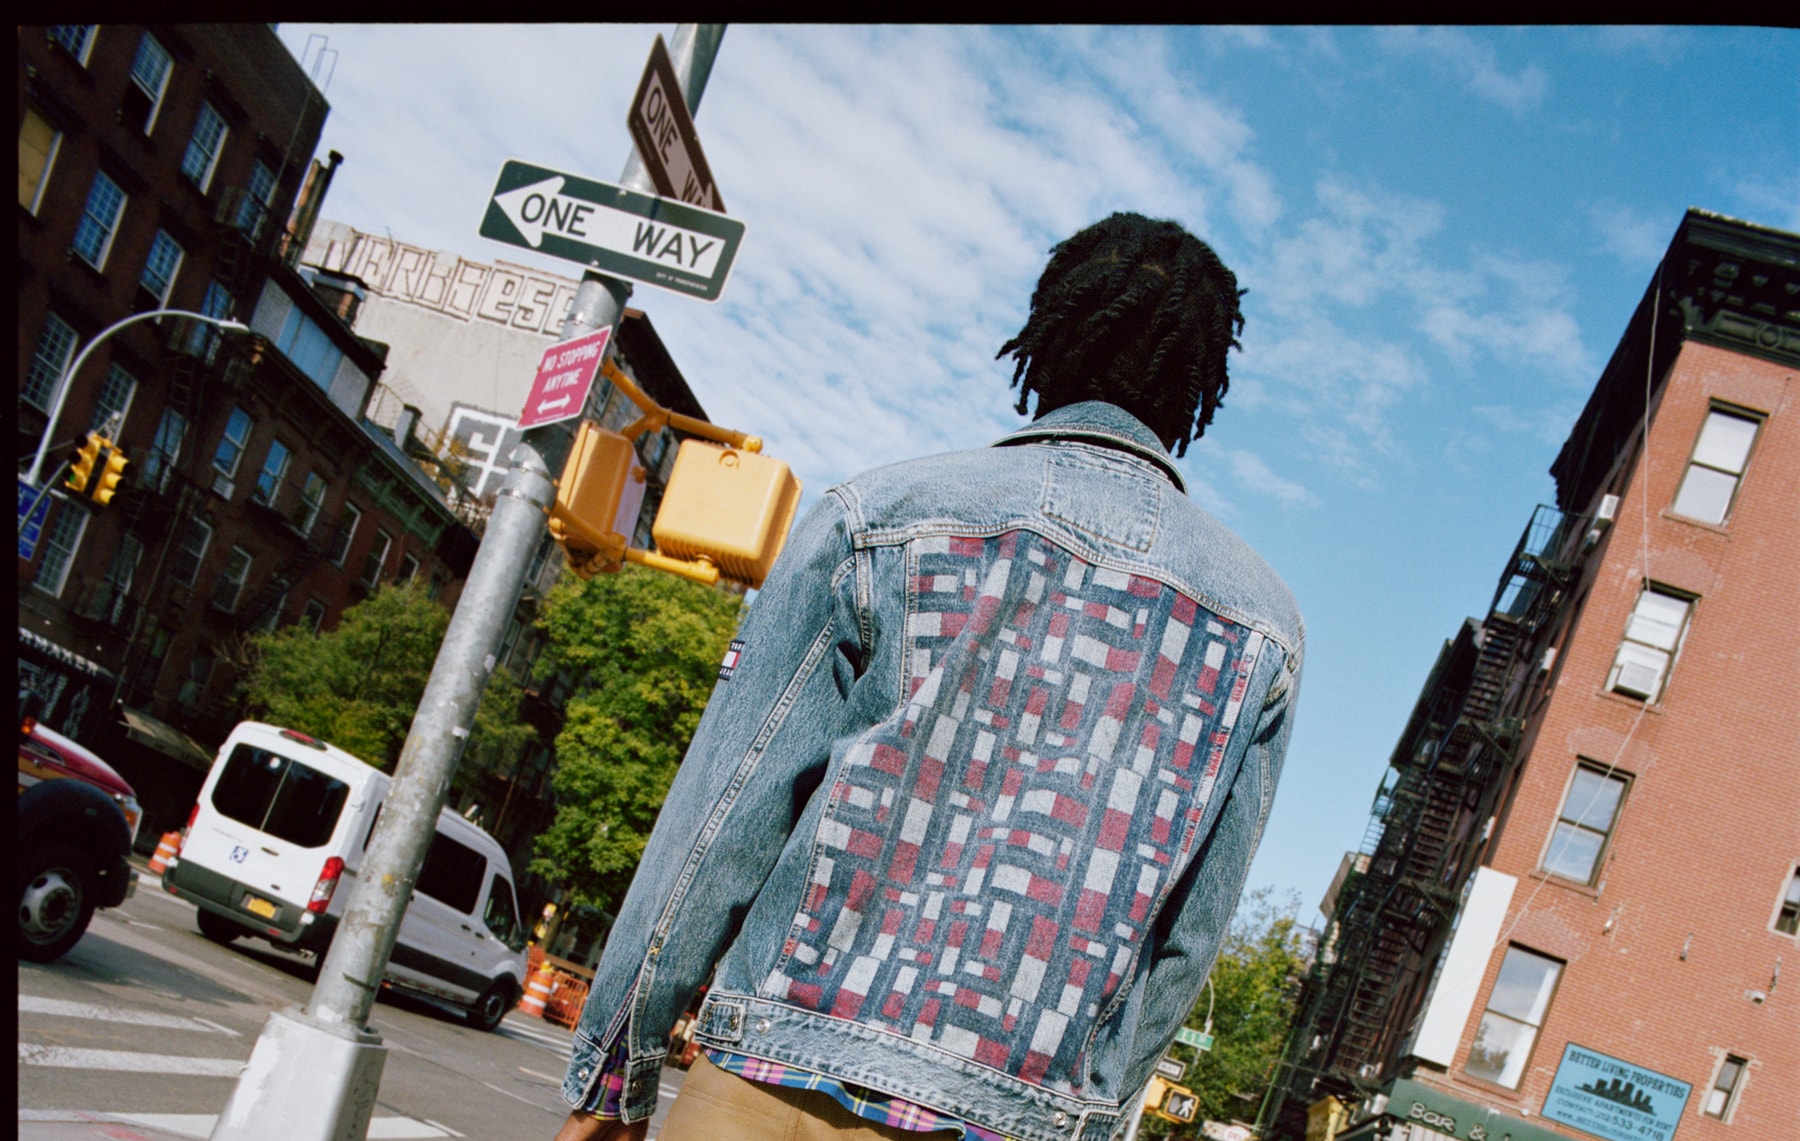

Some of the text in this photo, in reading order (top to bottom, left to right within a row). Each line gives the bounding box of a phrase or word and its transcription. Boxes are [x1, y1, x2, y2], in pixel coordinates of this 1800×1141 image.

[647, 87, 678, 165] ONE
[520, 193, 715, 268] ONE WAY
[542, 341, 600, 373] NO STOPPING
[542, 368, 583, 393] ANYTIME
[1569, 1050, 1686, 1099] BETTER LIVING PROPERTIES
